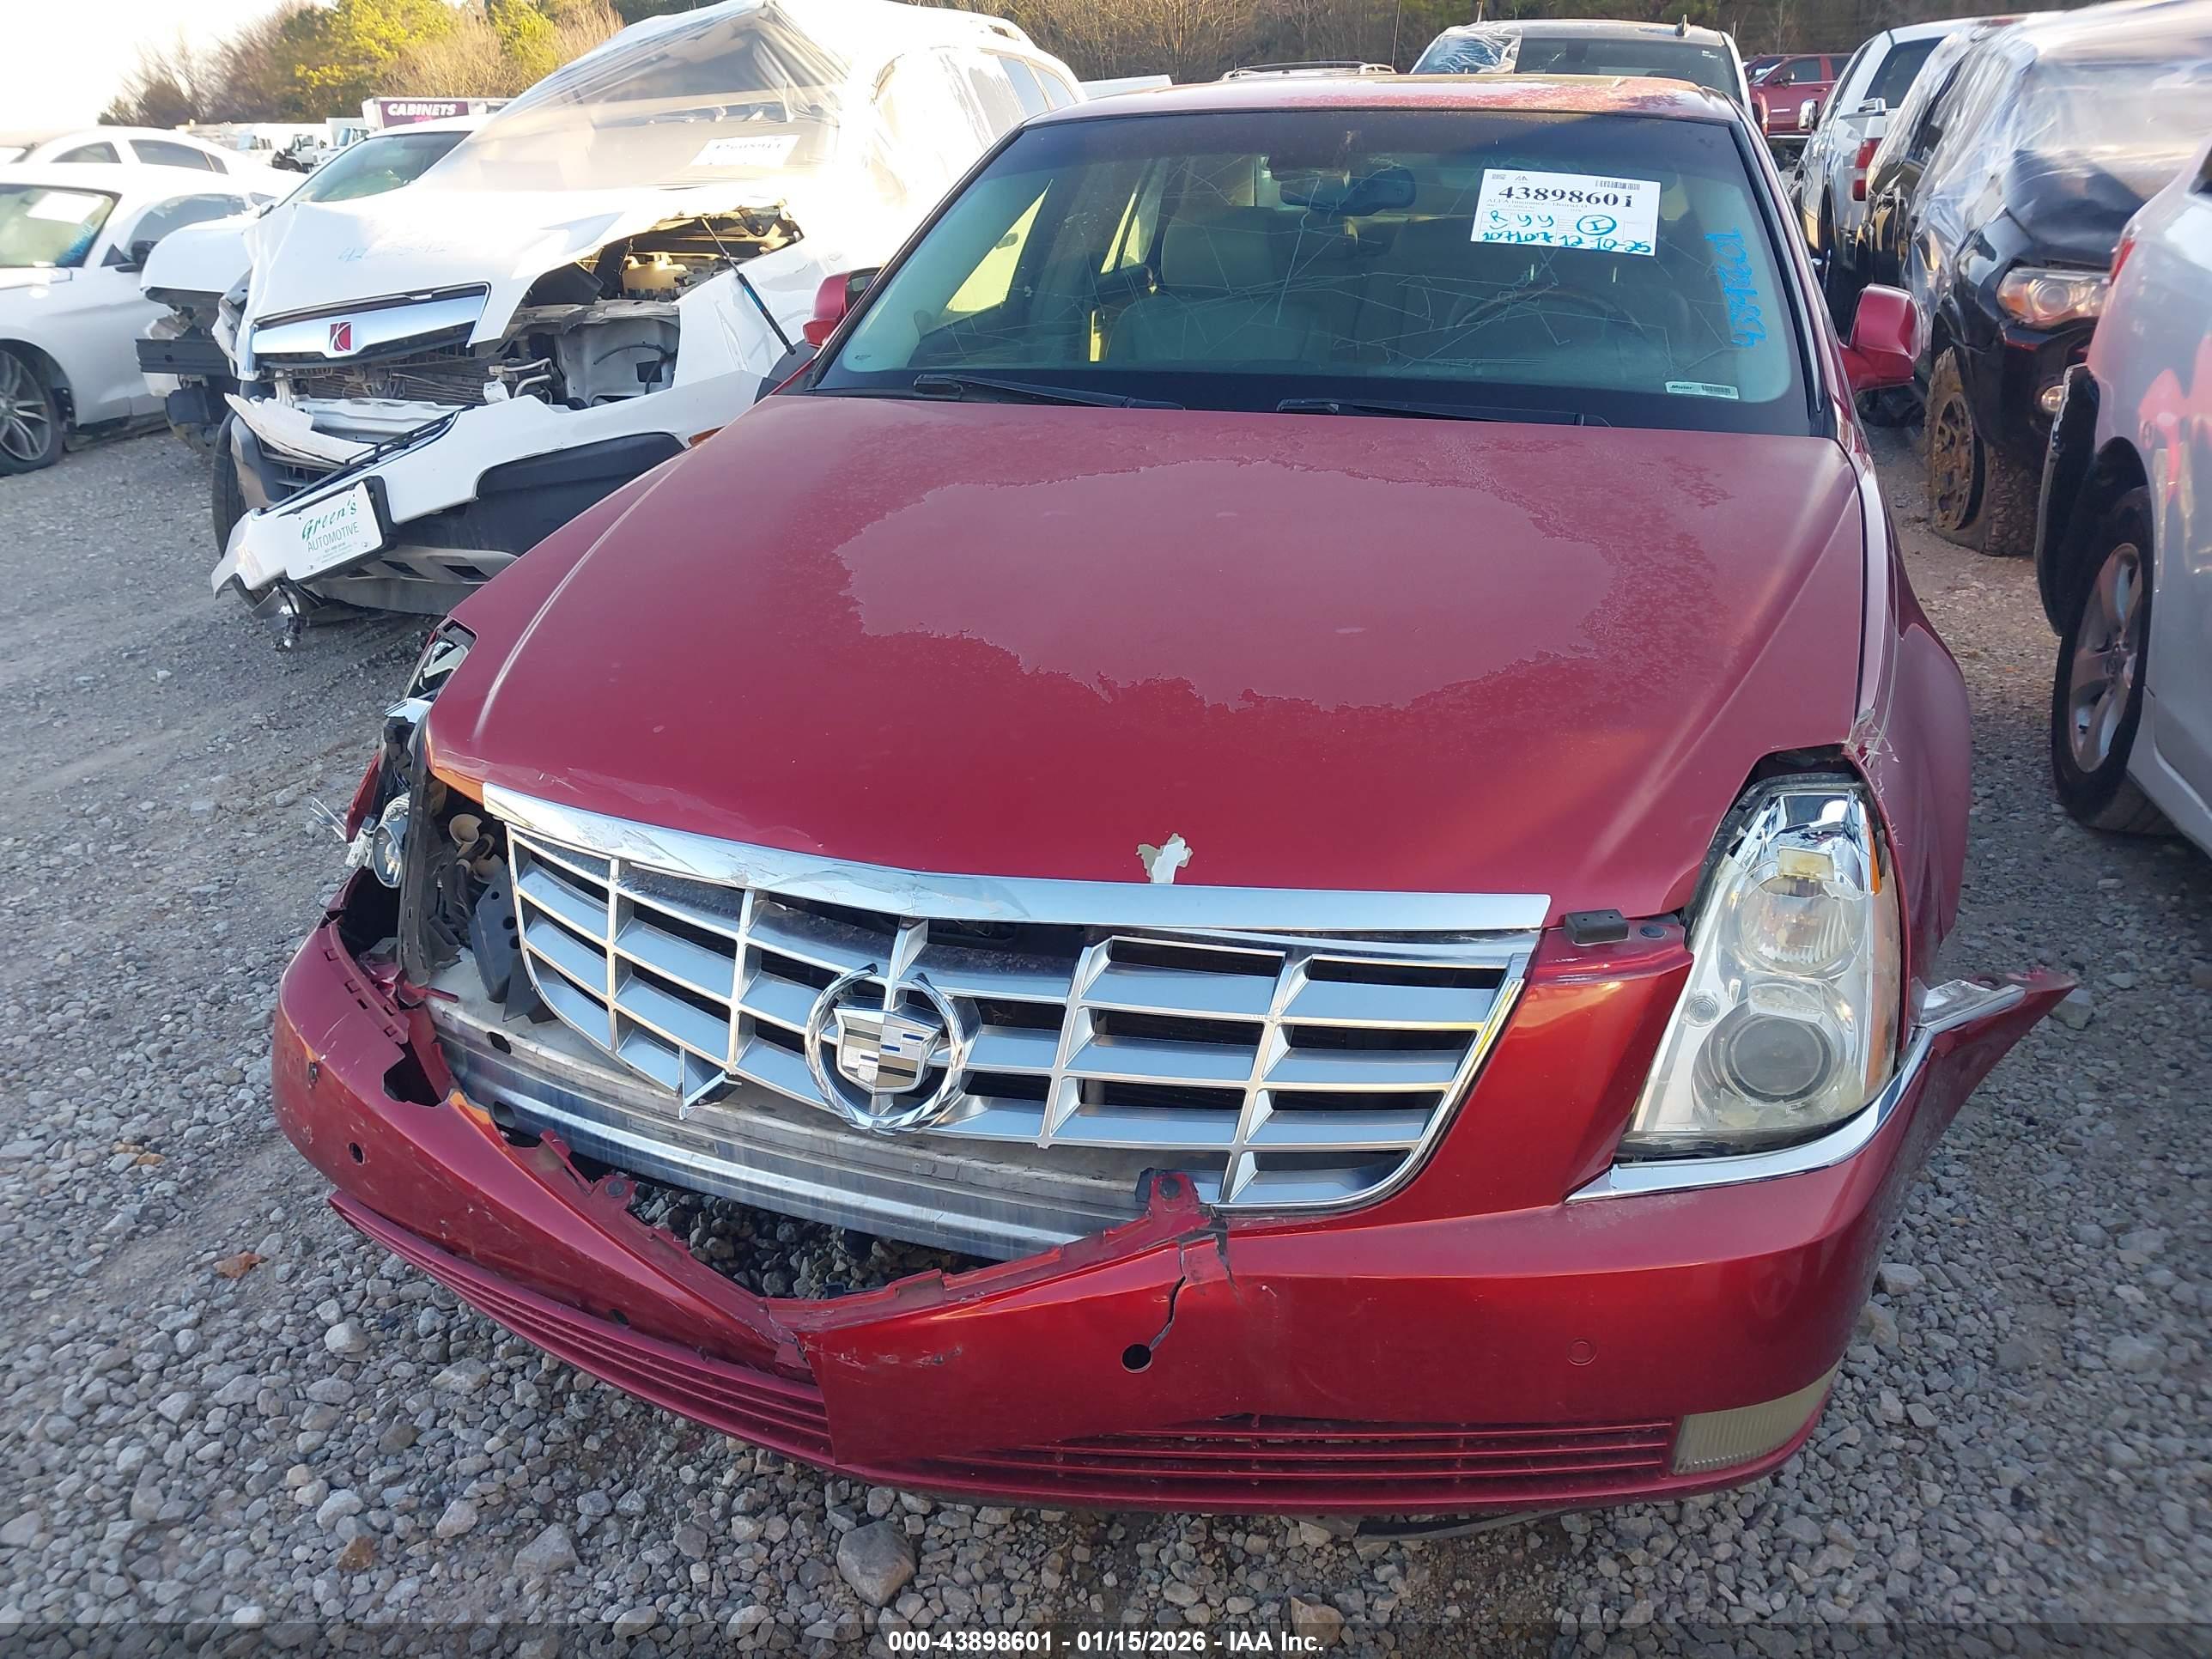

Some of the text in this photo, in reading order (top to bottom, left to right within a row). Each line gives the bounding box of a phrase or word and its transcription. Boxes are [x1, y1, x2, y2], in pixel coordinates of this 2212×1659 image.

[387, 103, 457, 116] CABINETS
[1498, 185, 1634, 208] 43898601
[302, 500, 356, 541] Green's
[307, 522, 359, 552] AUTOMOTIVE
